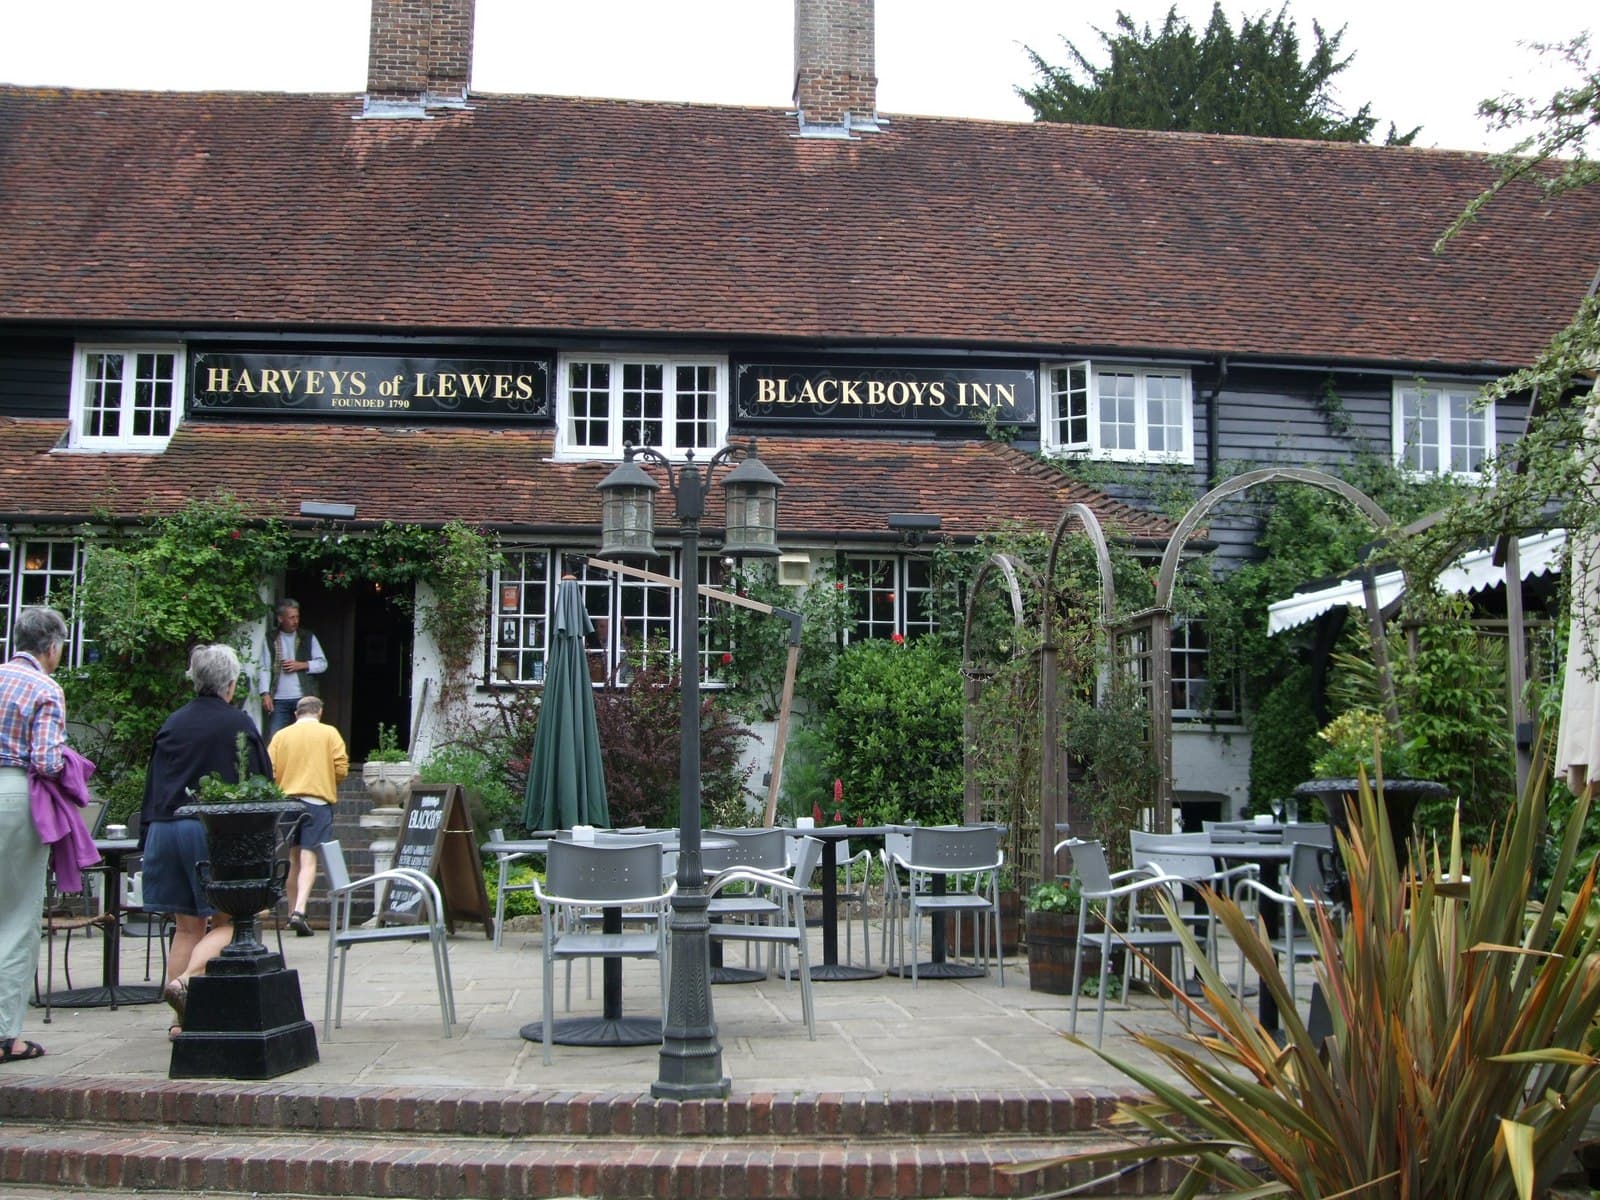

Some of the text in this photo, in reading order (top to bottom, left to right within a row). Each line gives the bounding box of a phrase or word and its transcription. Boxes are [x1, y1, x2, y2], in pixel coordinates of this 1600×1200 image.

[206, 366, 533, 400] HARVEYS of LEWES
[757, 378, 1015, 408] BLACKBOYS INN
[331, 398, 410, 409] FOUNDED 1790
